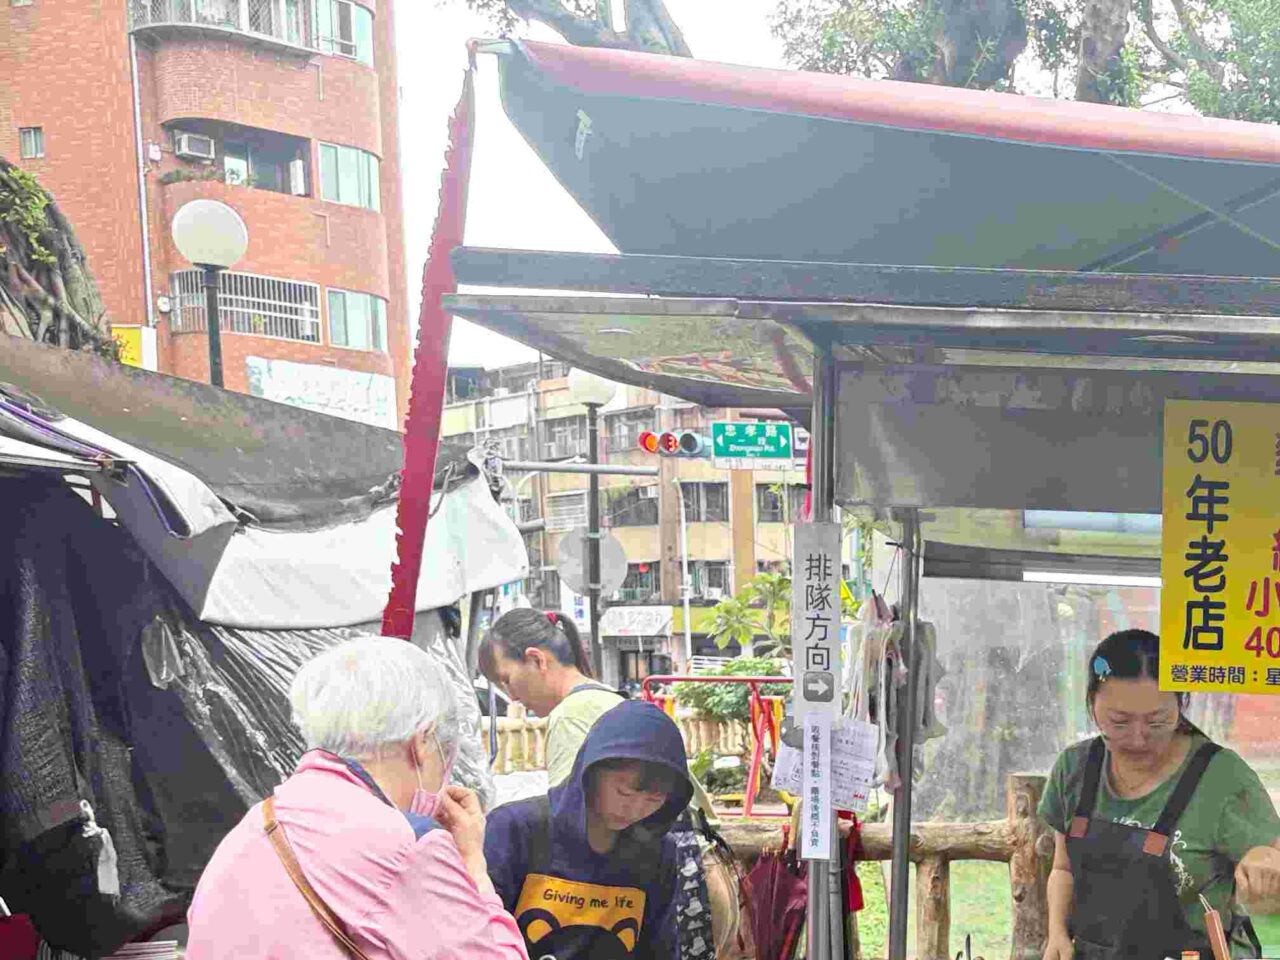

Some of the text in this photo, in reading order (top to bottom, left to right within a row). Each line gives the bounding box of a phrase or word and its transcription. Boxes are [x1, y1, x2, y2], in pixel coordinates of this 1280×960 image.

[804, 553, 833, 671] 排隊方向
[543, 888, 634, 910] Giving me life
